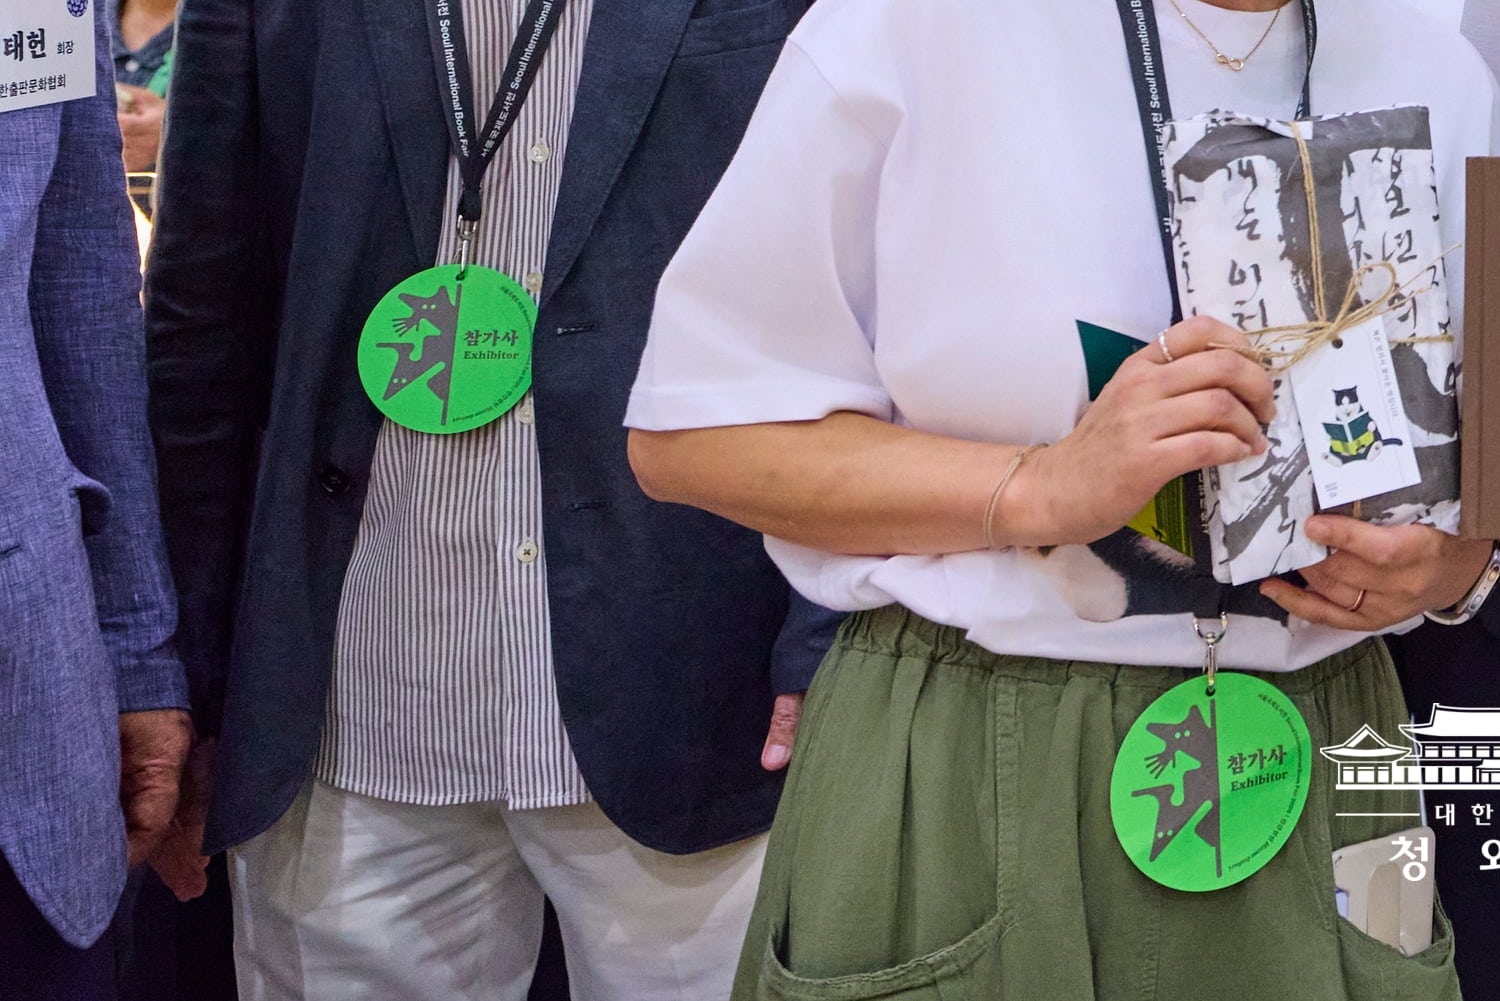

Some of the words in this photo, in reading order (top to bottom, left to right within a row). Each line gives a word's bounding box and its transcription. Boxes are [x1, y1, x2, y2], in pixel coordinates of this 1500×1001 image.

[3, 28, 47, 62] 태헌
[57, 40, 75, 55] 회장
[440, 19, 453, 48] Seoul
[510, 60, 527, 90] Seoul
[522, 1, 553, 63] International
[1136, 10, 1155, 76] International
[444, 48, 461, 110] International
[1146, 76, 1161, 108] Seoul
[454, 110, 466, 139] Book
[459, 139, 470, 158] Fair
[463, 329, 519, 347] 참가사
[463, 351, 520, 360] Exhibitor
[1227, 744, 1287, 776] 참가사
[1230, 770, 1288, 792] Exhibitor
